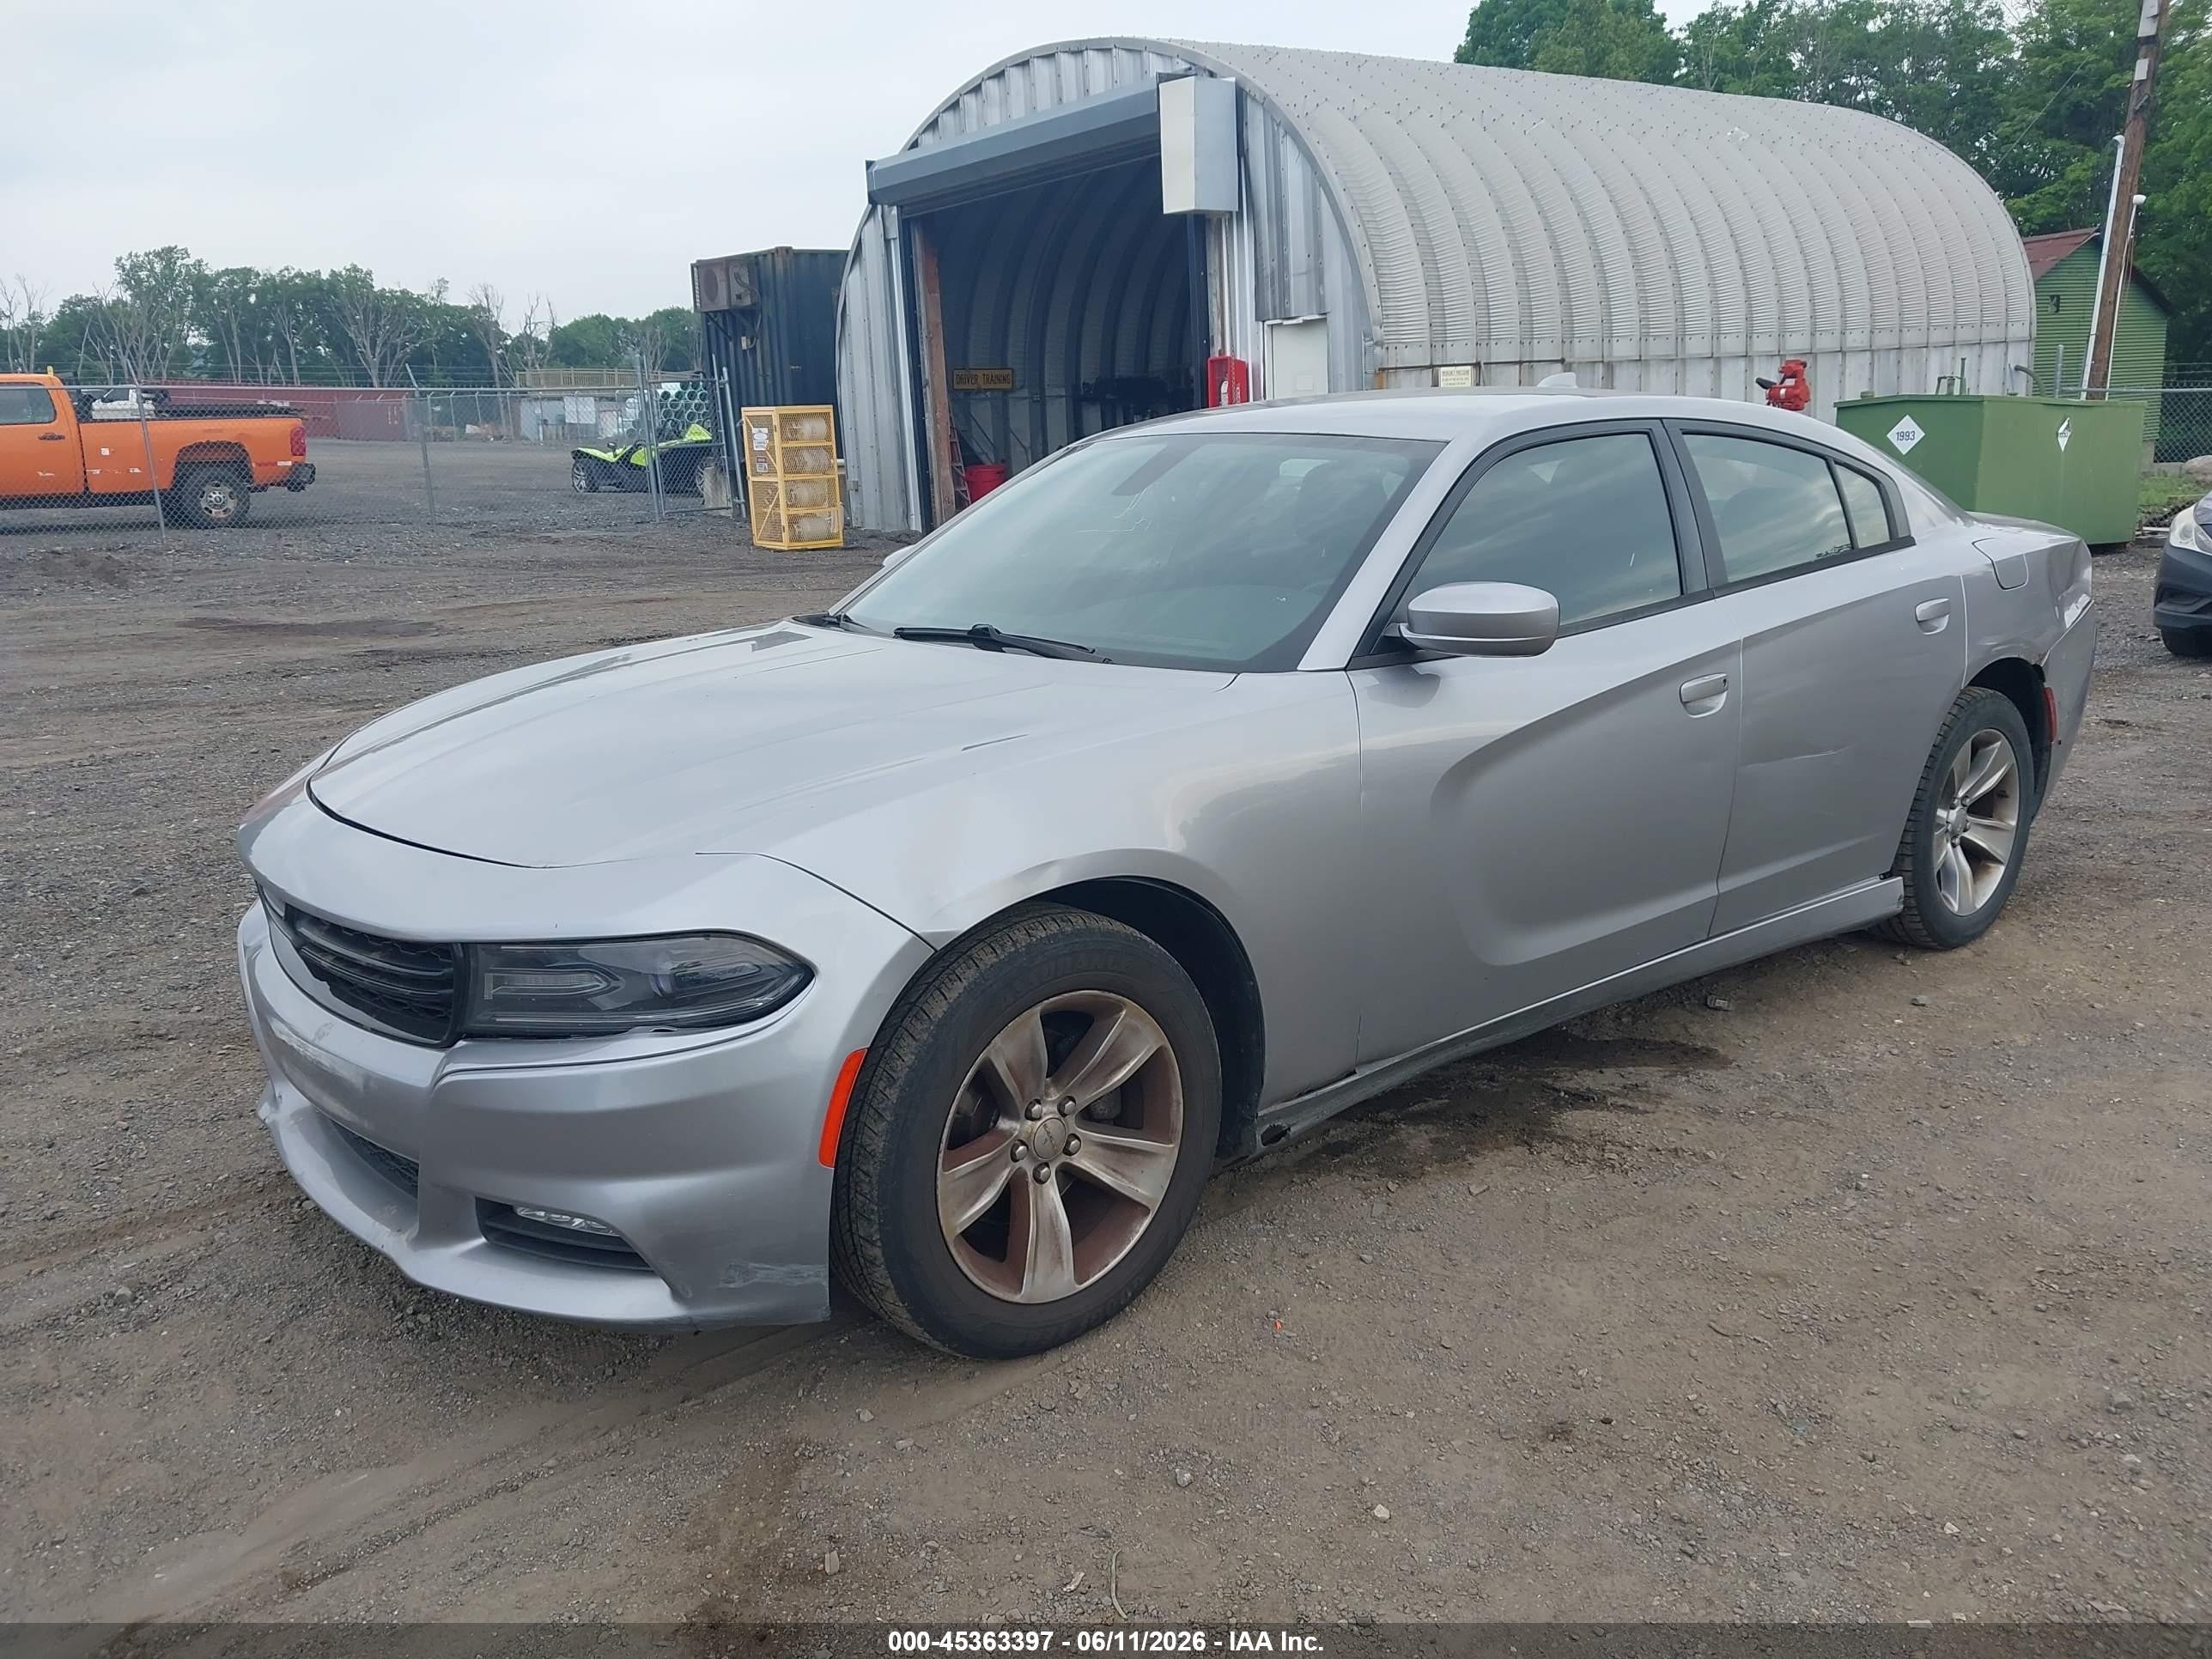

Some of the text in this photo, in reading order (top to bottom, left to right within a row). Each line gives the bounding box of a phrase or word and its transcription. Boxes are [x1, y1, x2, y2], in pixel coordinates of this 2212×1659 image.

[955, 373, 1012, 386] DRIVER TRAINING
[1895, 430, 1916, 441] 1993
